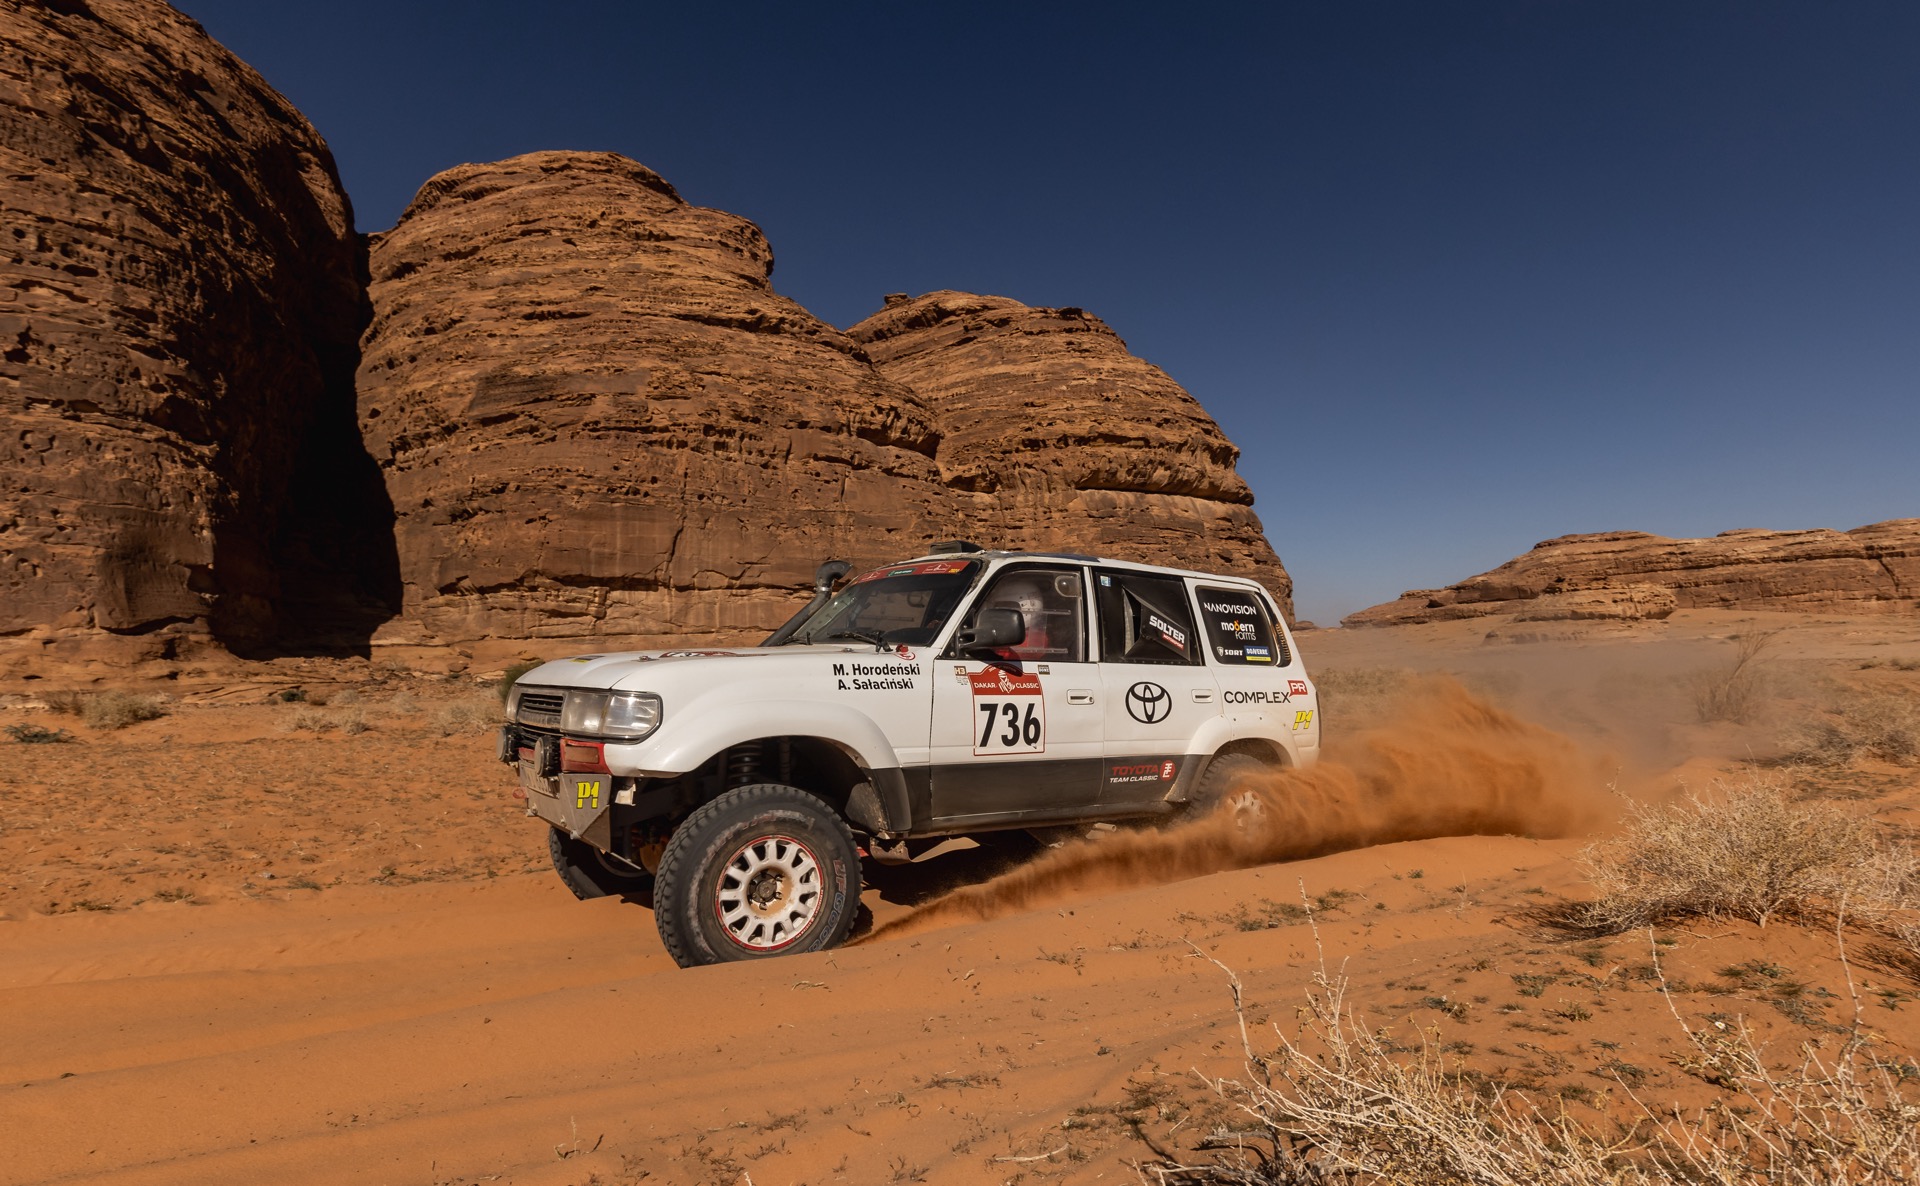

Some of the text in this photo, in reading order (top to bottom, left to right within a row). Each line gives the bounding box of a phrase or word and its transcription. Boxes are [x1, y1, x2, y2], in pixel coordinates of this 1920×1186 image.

[1203, 602, 1257, 615] NANOVISION
[1149, 615, 1185, 644] SOLTER
[1221, 620, 1255, 632] modern
[832, 662, 920, 676] M. Horodeński
[838, 677, 914, 690] A. Sałaciński
[1224, 682, 1306, 704] COMPLEX PR
[979, 702, 1041, 748] 736
[1292, 710, 1314, 730] P1
[1112, 764, 1159, 776] TOYOTA
[1130, 774, 1158, 782] CLASSIC
[576, 781, 600, 809] P1
